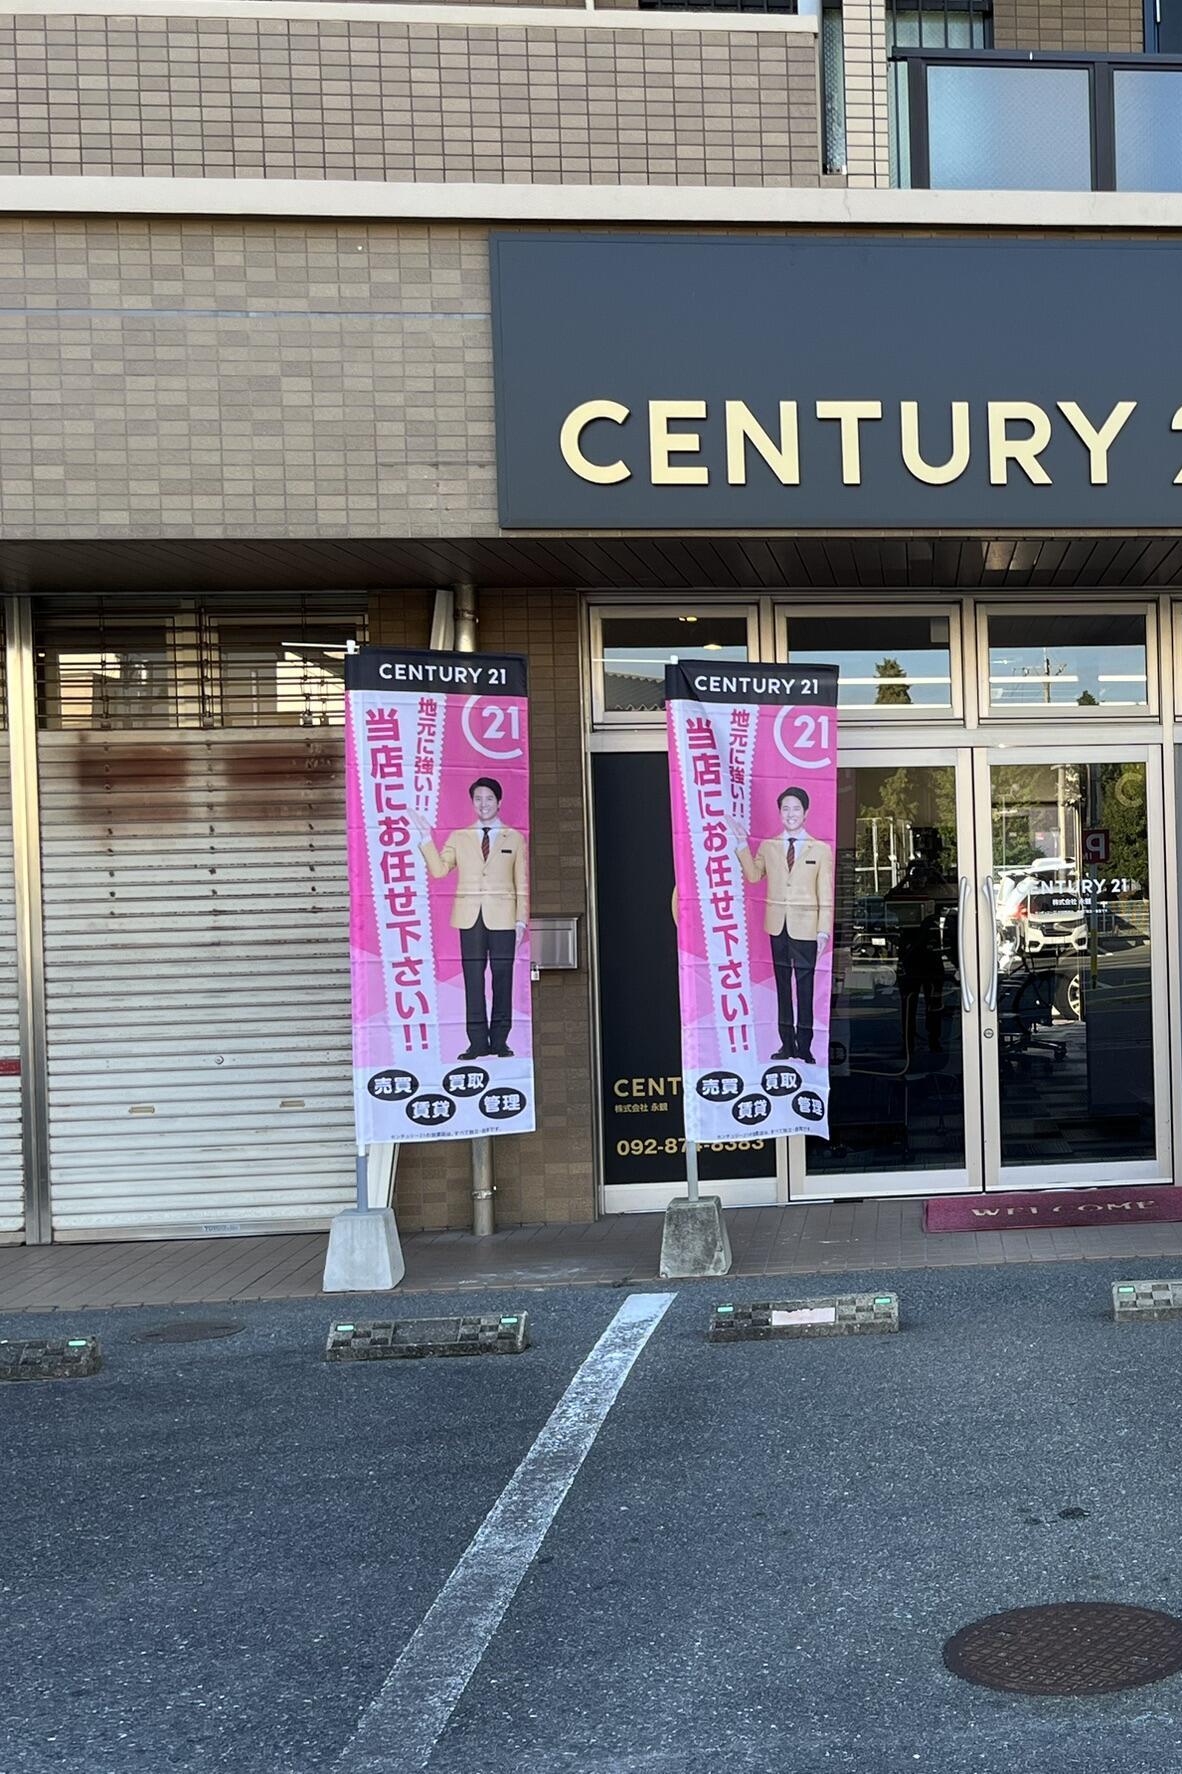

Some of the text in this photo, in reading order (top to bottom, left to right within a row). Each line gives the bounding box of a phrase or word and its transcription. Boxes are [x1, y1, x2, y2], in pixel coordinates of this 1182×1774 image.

[559, 399, 1138, 487] CENTURY
[379, 663, 507, 685] CENTURY 21
[694, 675, 819, 695] CENTURY 21
[1111, 878, 1127, 894] 21
[374, 1076, 412, 1095] 売買
[449, 1072, 484, 1092] 買取
[701, 1078, 739, 1096] 売買
[765, 1072, 798, 1091] 買取
[412, 1100, 450, 1119] 賃貸
[483, 1094, 521, 1113] 管理
[737, 1099, 768, 1119] 賃貸
[797, 1096, 824, 1116] 管理
